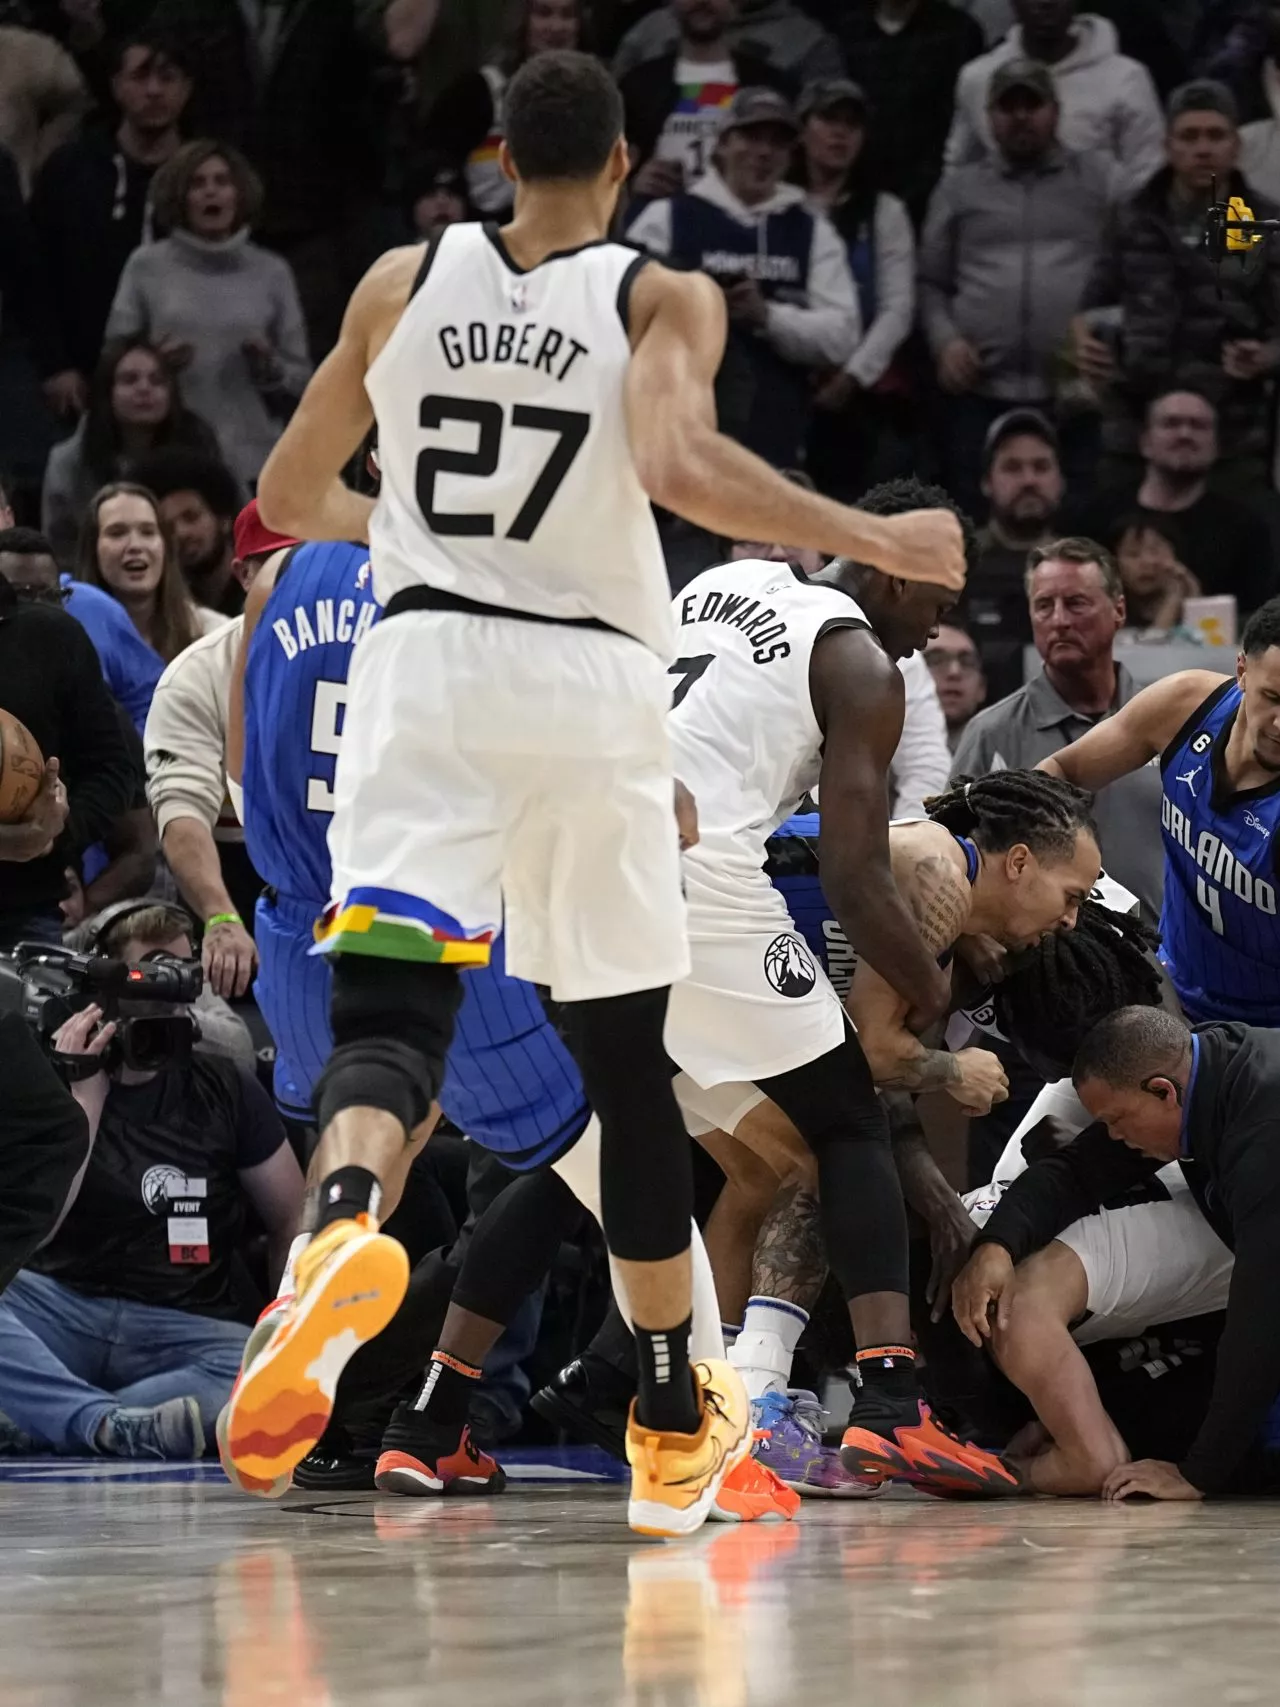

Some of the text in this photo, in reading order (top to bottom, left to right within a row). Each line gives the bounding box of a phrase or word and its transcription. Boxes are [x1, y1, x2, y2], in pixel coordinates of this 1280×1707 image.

[439, 322, 589, 382] GOBERT
[415, 394, 591, 543] 27
[272, 598, 378, 661] BANCH
[681, 591, 791, 665] EDWARDS
[1192, 734, 1211, 753] 6
[1161, 793, 1277, 915] ORLANDO
[1197, 874, 1224, 936] 4
[173, 1201, 201, 1213] EVENT
